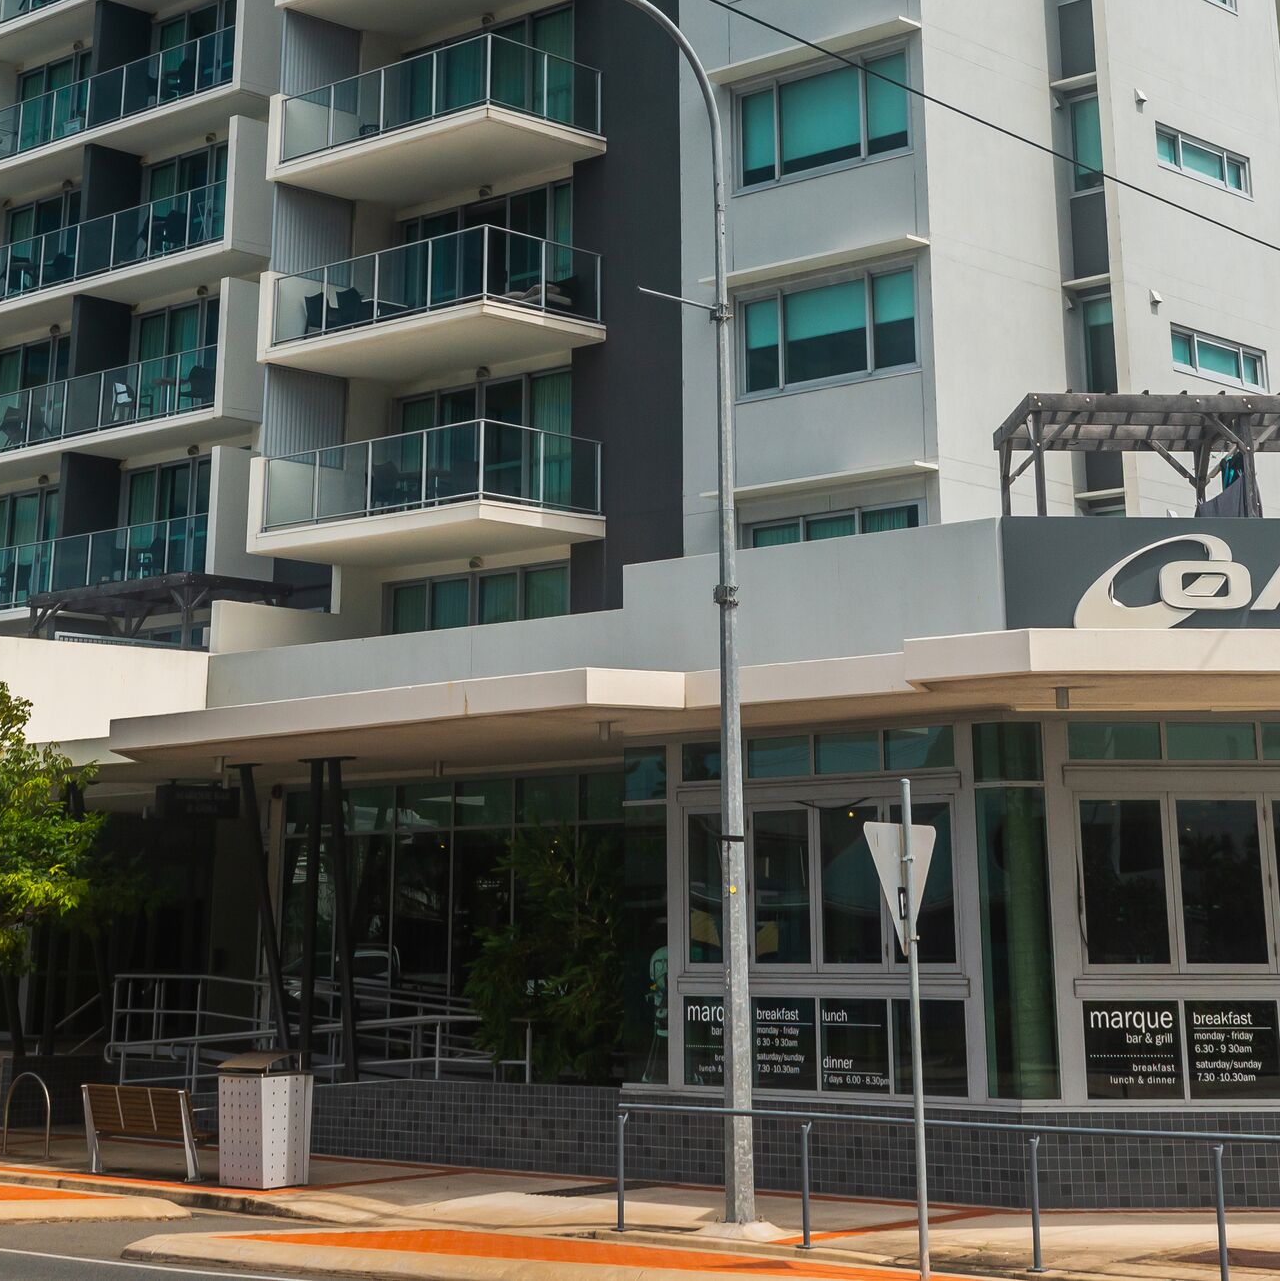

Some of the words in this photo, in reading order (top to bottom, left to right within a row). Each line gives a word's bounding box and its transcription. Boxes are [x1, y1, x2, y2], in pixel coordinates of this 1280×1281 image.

[687, 1005, 725, 1027] marq
[756, 1007, 799, 1020] breakfast
[822, 1009, 848, 1022] lunch
[1192, 1011, 1253, 1025] breakfast
[1090, 1010, 1173, 1033] marque
[756, 1026, 779, 1036] monday
[783, 1026, 800, 1036] friday
[1194, 1031, 1225, 1042] monday
[1231, 1031, 1253, 1042] friday
[1125, 1032, 1142, 1044] bar
[1144, 1032, 1153, 1044] &
[1155, 1033, 1173, 1046] grill
[1194, 1043, 1214, 1053] 6.30
[822, 1055, 854, 1069] dinner
[1132, 1063, 1176, 1073] breakfast
[1195, 1059, 1263, 1071] saturday/sunday
[823, 1074, 828, 1083] 7
[829, 1074, 843, 1086] days
[846, 1075, 861, 1084] 6.00
[1110, 1075, 1135, 1085] lunch
[1137, 1075, 1144, 1085] &
[1147, 1075, 1176, 1085] dinner
